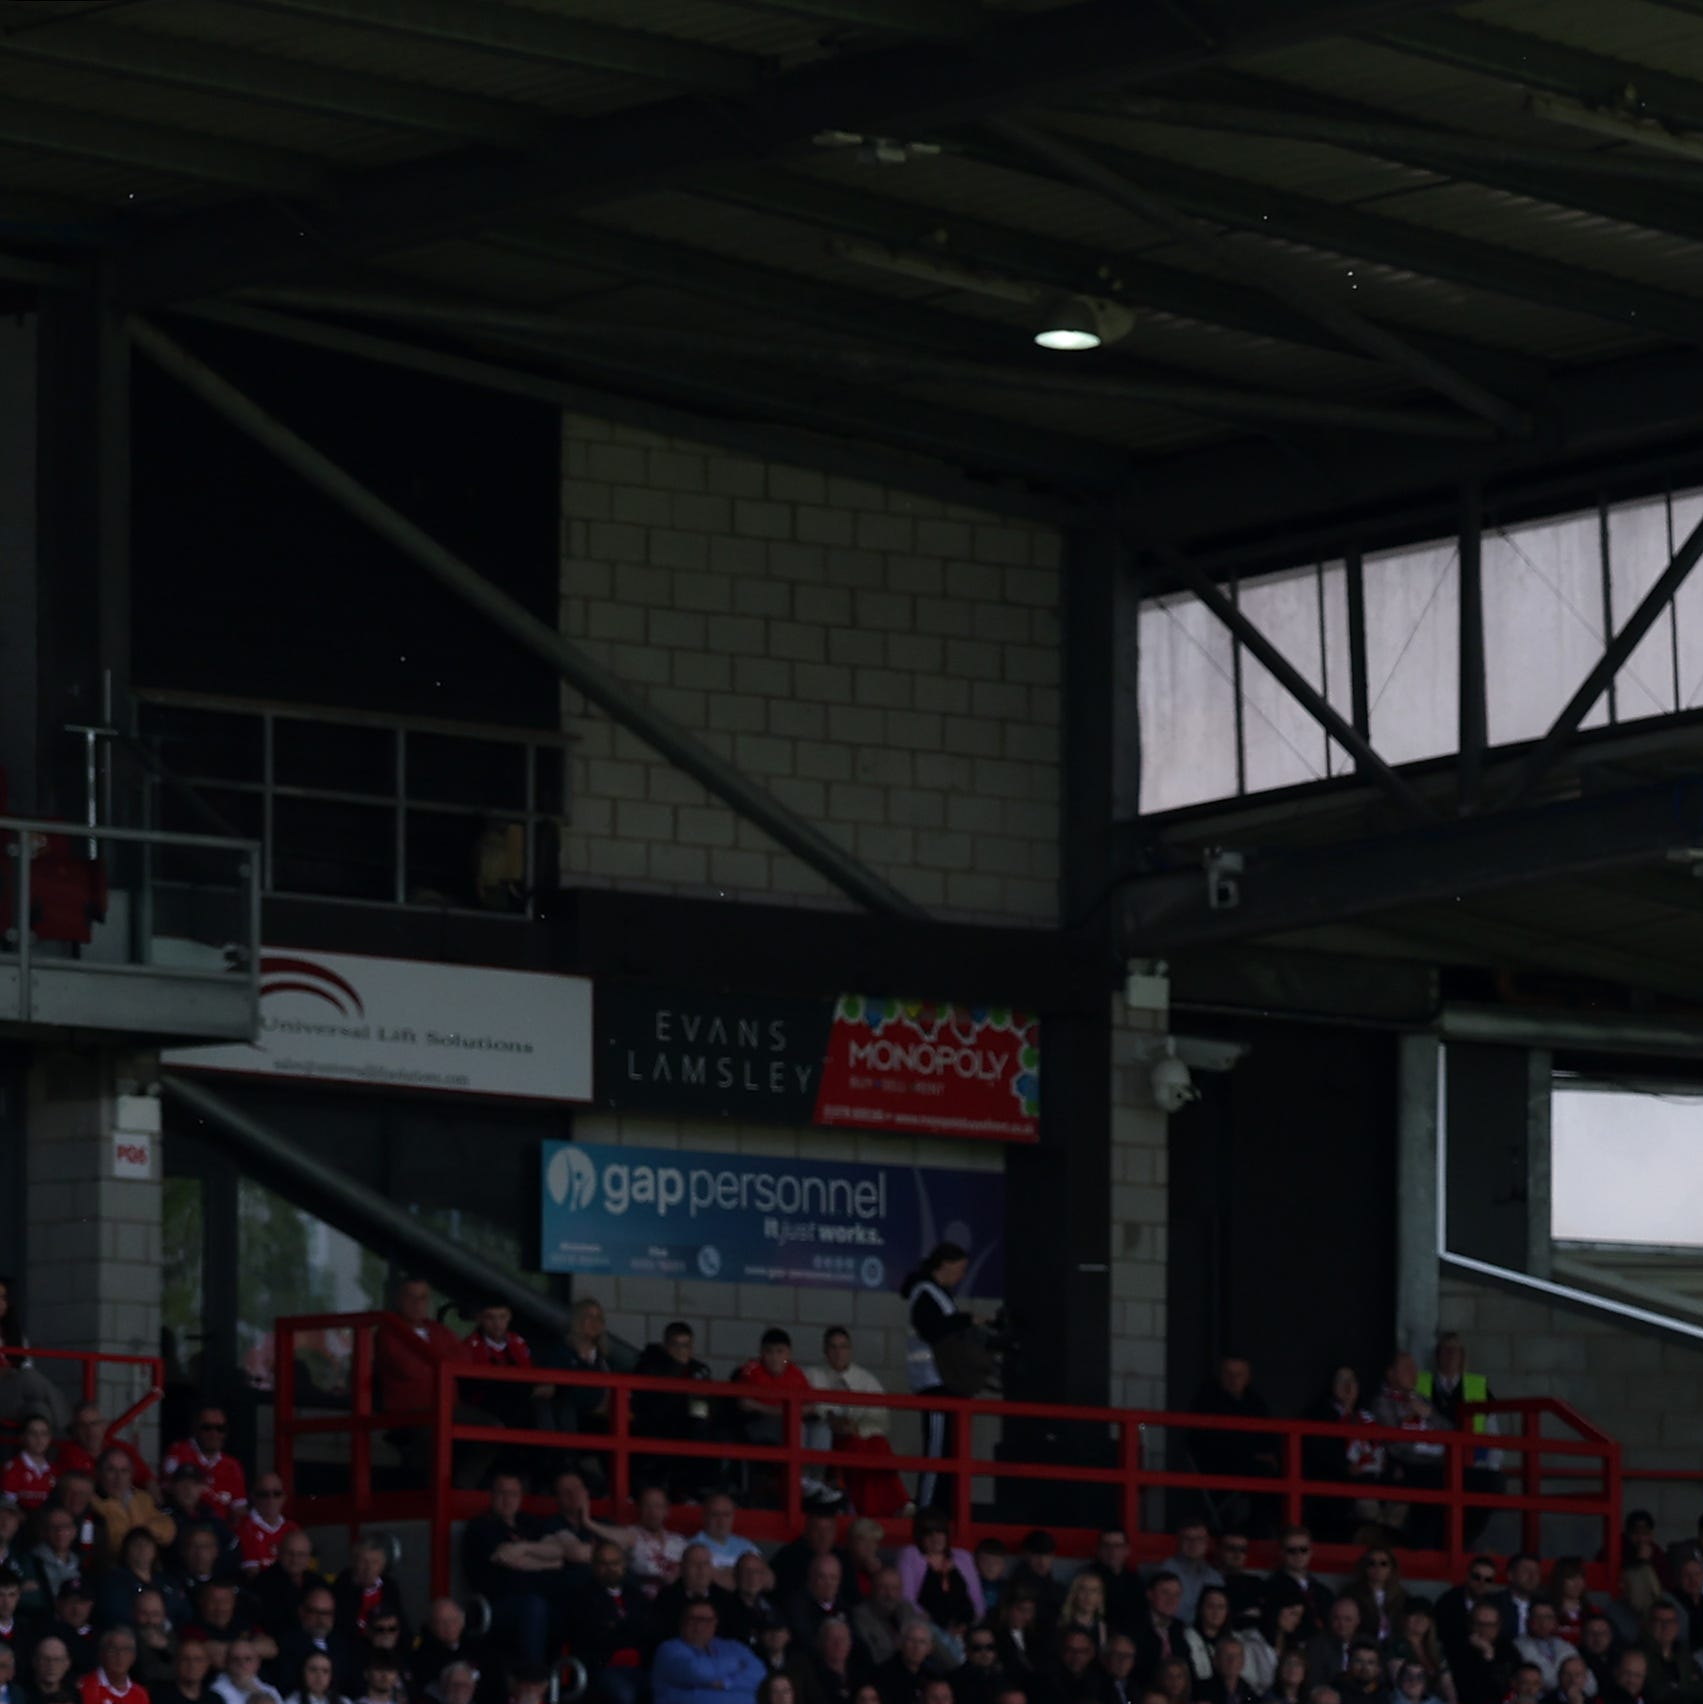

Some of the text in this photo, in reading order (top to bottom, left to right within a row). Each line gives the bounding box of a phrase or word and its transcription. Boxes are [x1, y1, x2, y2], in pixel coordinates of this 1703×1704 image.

[377, 1025, 416, 1045] Lift
[424, 1030, 534, 1054] Solutions
[656, 1009, 787, 1052] EVANS
[627, 1049, 812, 1094] LAMSLEY
[848, 1039, 1008, 1080] MONOPOLY
[818, 1222, 886, 1245] works.
